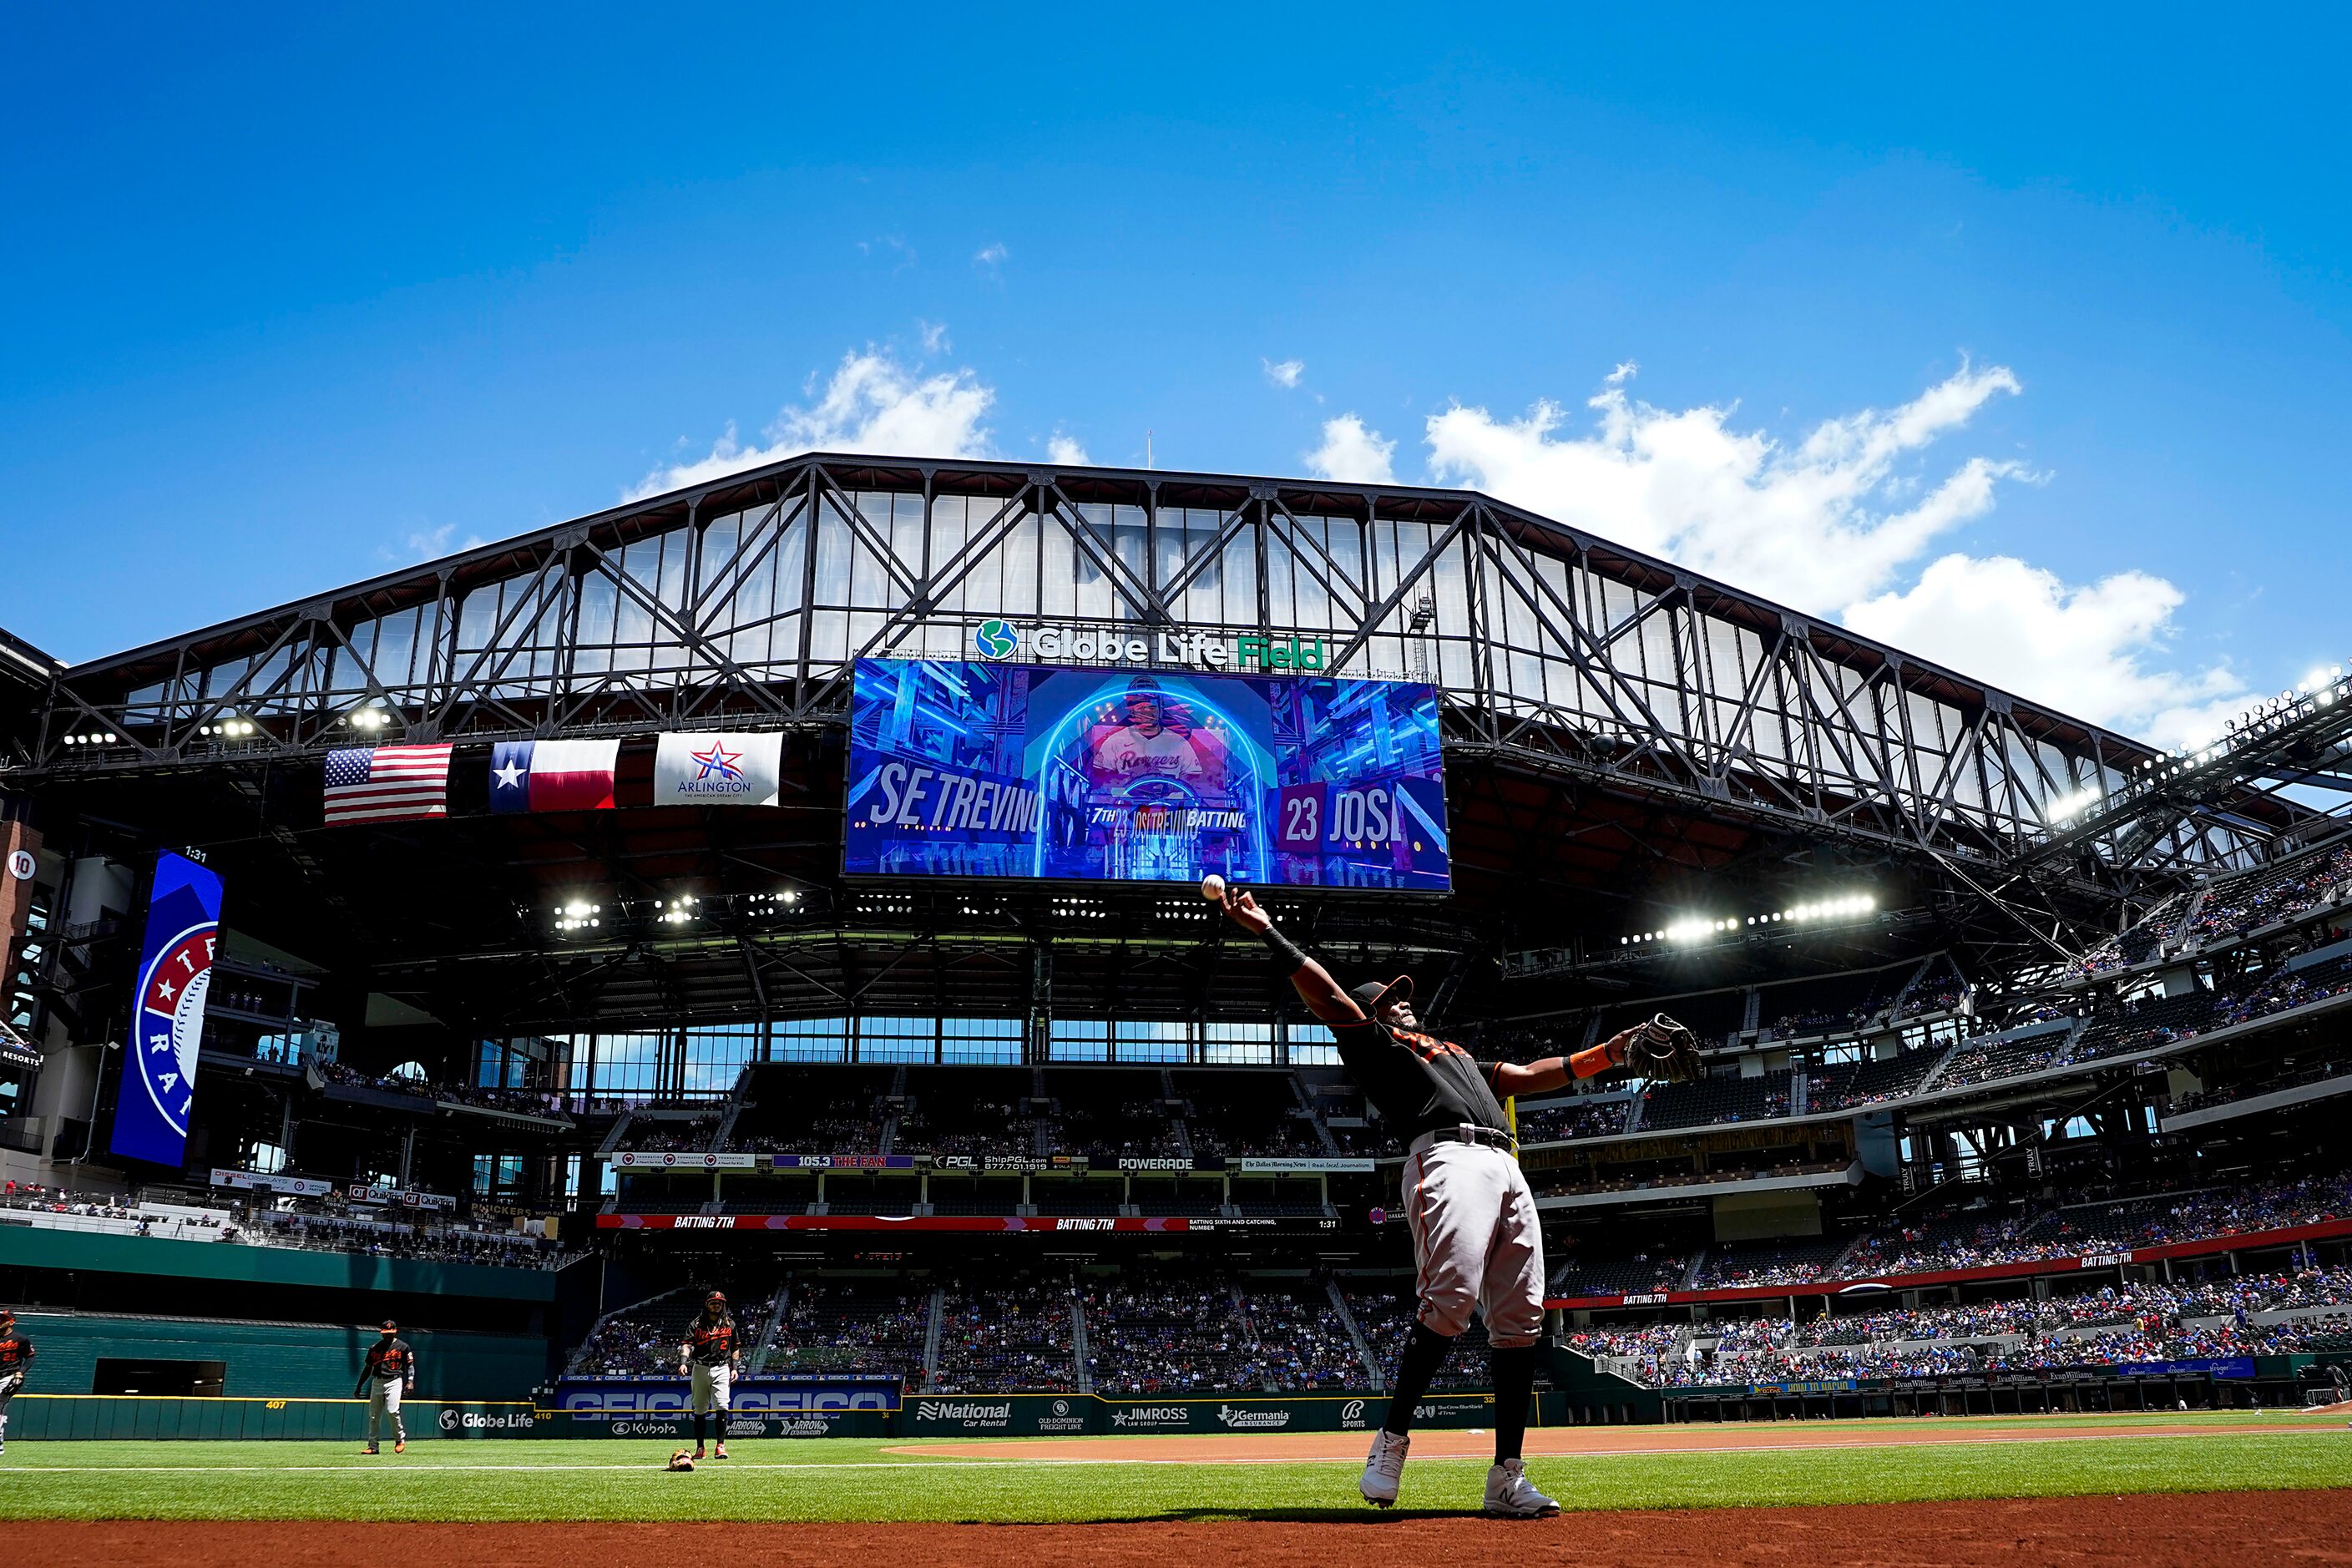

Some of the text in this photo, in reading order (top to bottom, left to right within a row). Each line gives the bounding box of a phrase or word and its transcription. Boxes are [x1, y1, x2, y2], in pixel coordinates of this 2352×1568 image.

[1031, 627, 1323, 670] Globe Life Field
[678, 781, 751, 792] ARLINGTON
[870, 762, 933, 825] SE
[1091, 807, 1246, 829] 7TH BATTING
[1286, 797, 1318, 841] 23
[185, 846, 207, 862] 1:31
[15, 855, 30, 874] 10
[3, 1051, 39, 1066] RESORTS
[798, 1156, 886, 1167] 105.3 THE FAN
[946, 1156, 978, 1166] PGL
[984, 1156, 1047, 1164] ShipPGL.com
[1119, 1158, 1193, 1169] POWERADE
[2026, 1147, 2036, 1173] TRULY
[1900, 1167, 1910, 1191] TRULY
[352, 1187, 366, 1198] QT
[405, 1194, 419, 1204] QT
[674, 1216, 736, 1227] BATTING 7TH
[1056, 1219, 1115, 1230] BATTING 7TH
[2081, 1252, 2132, 1267] BATTING 7TH
[1623, 1293, 1667, 1304] BATTING 7TH
[720, 1340, 727, 1350] 2
[266, 1401, 286, 1409] 407
[733, 1393, 887, 1420] GEICO
[938, 1403, 1009, 1419] National
[1237, 1410, 1289, 1420] Germania
[462, 1413, 534, 1428] Globe Life
[729, 1420, 759, 1430] ARROW
[792, 1420, 822, 1430] ARROW
[632, 1423, 677, 1434] Kubota
